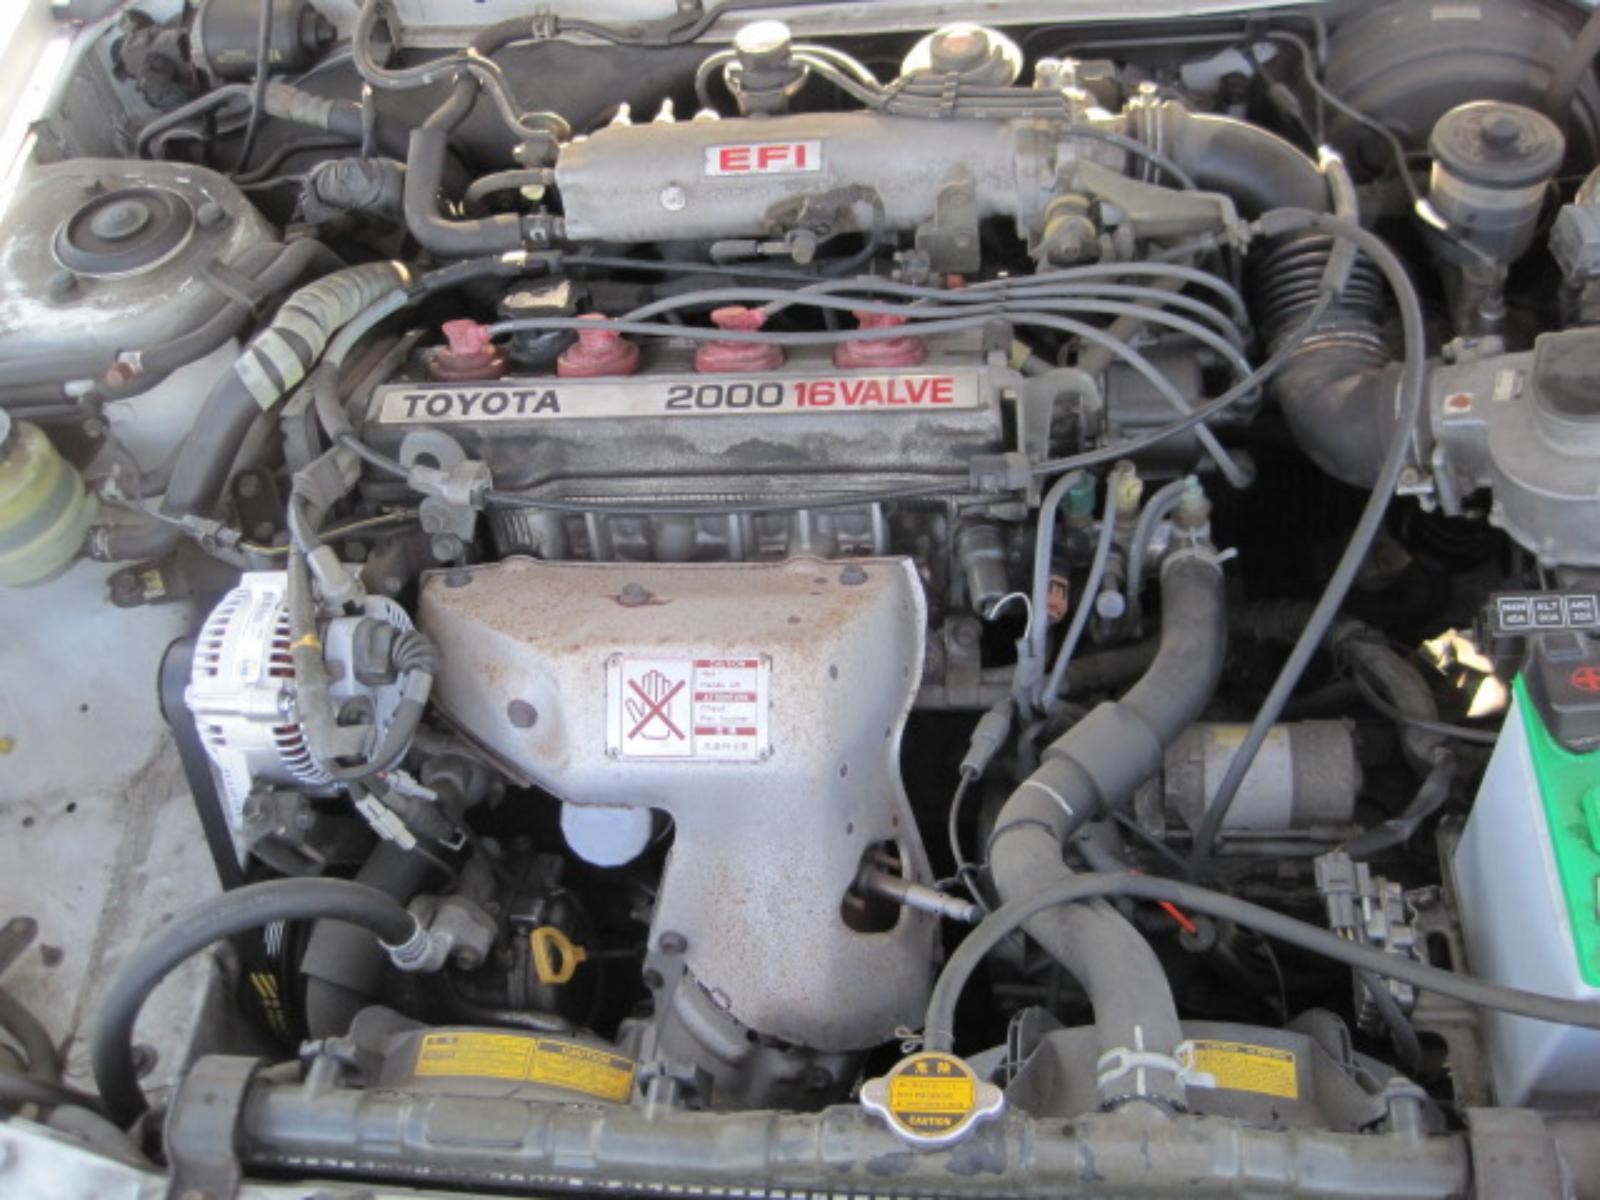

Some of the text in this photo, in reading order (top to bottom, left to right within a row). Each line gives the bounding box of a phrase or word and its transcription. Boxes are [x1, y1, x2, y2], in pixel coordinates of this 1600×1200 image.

[719, 144, 806, 171] EFI
[403, 388, 561, 418] TOYOTA
[665, 382, 784, 410] 2000
[909, 1116, 951, 1127] CAUTION
